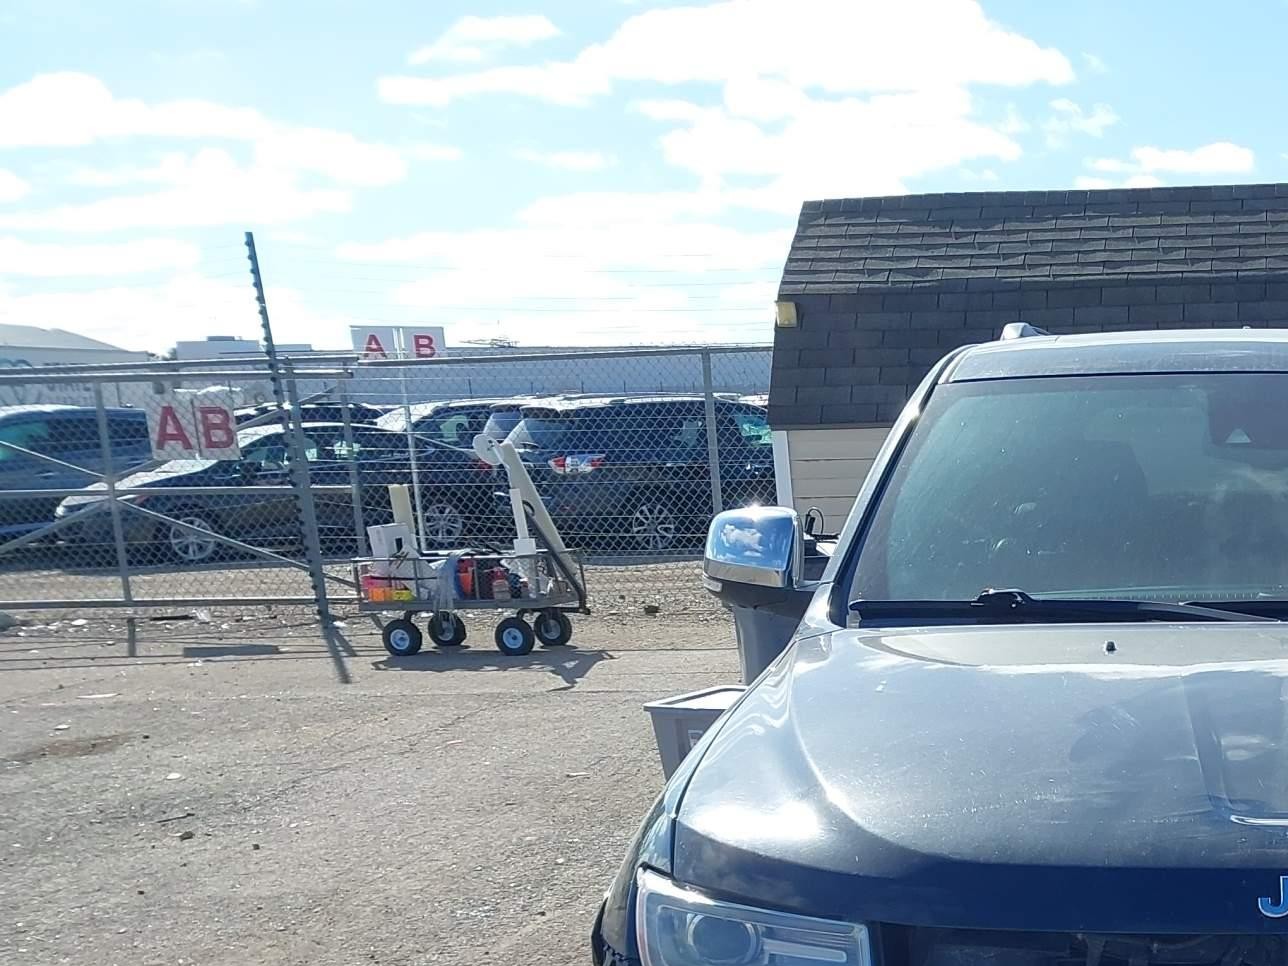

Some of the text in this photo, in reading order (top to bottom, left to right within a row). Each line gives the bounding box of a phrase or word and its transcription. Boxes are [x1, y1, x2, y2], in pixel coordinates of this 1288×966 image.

[363, 334, 436, 358] A B
[156, 405, 235, 450] A B
